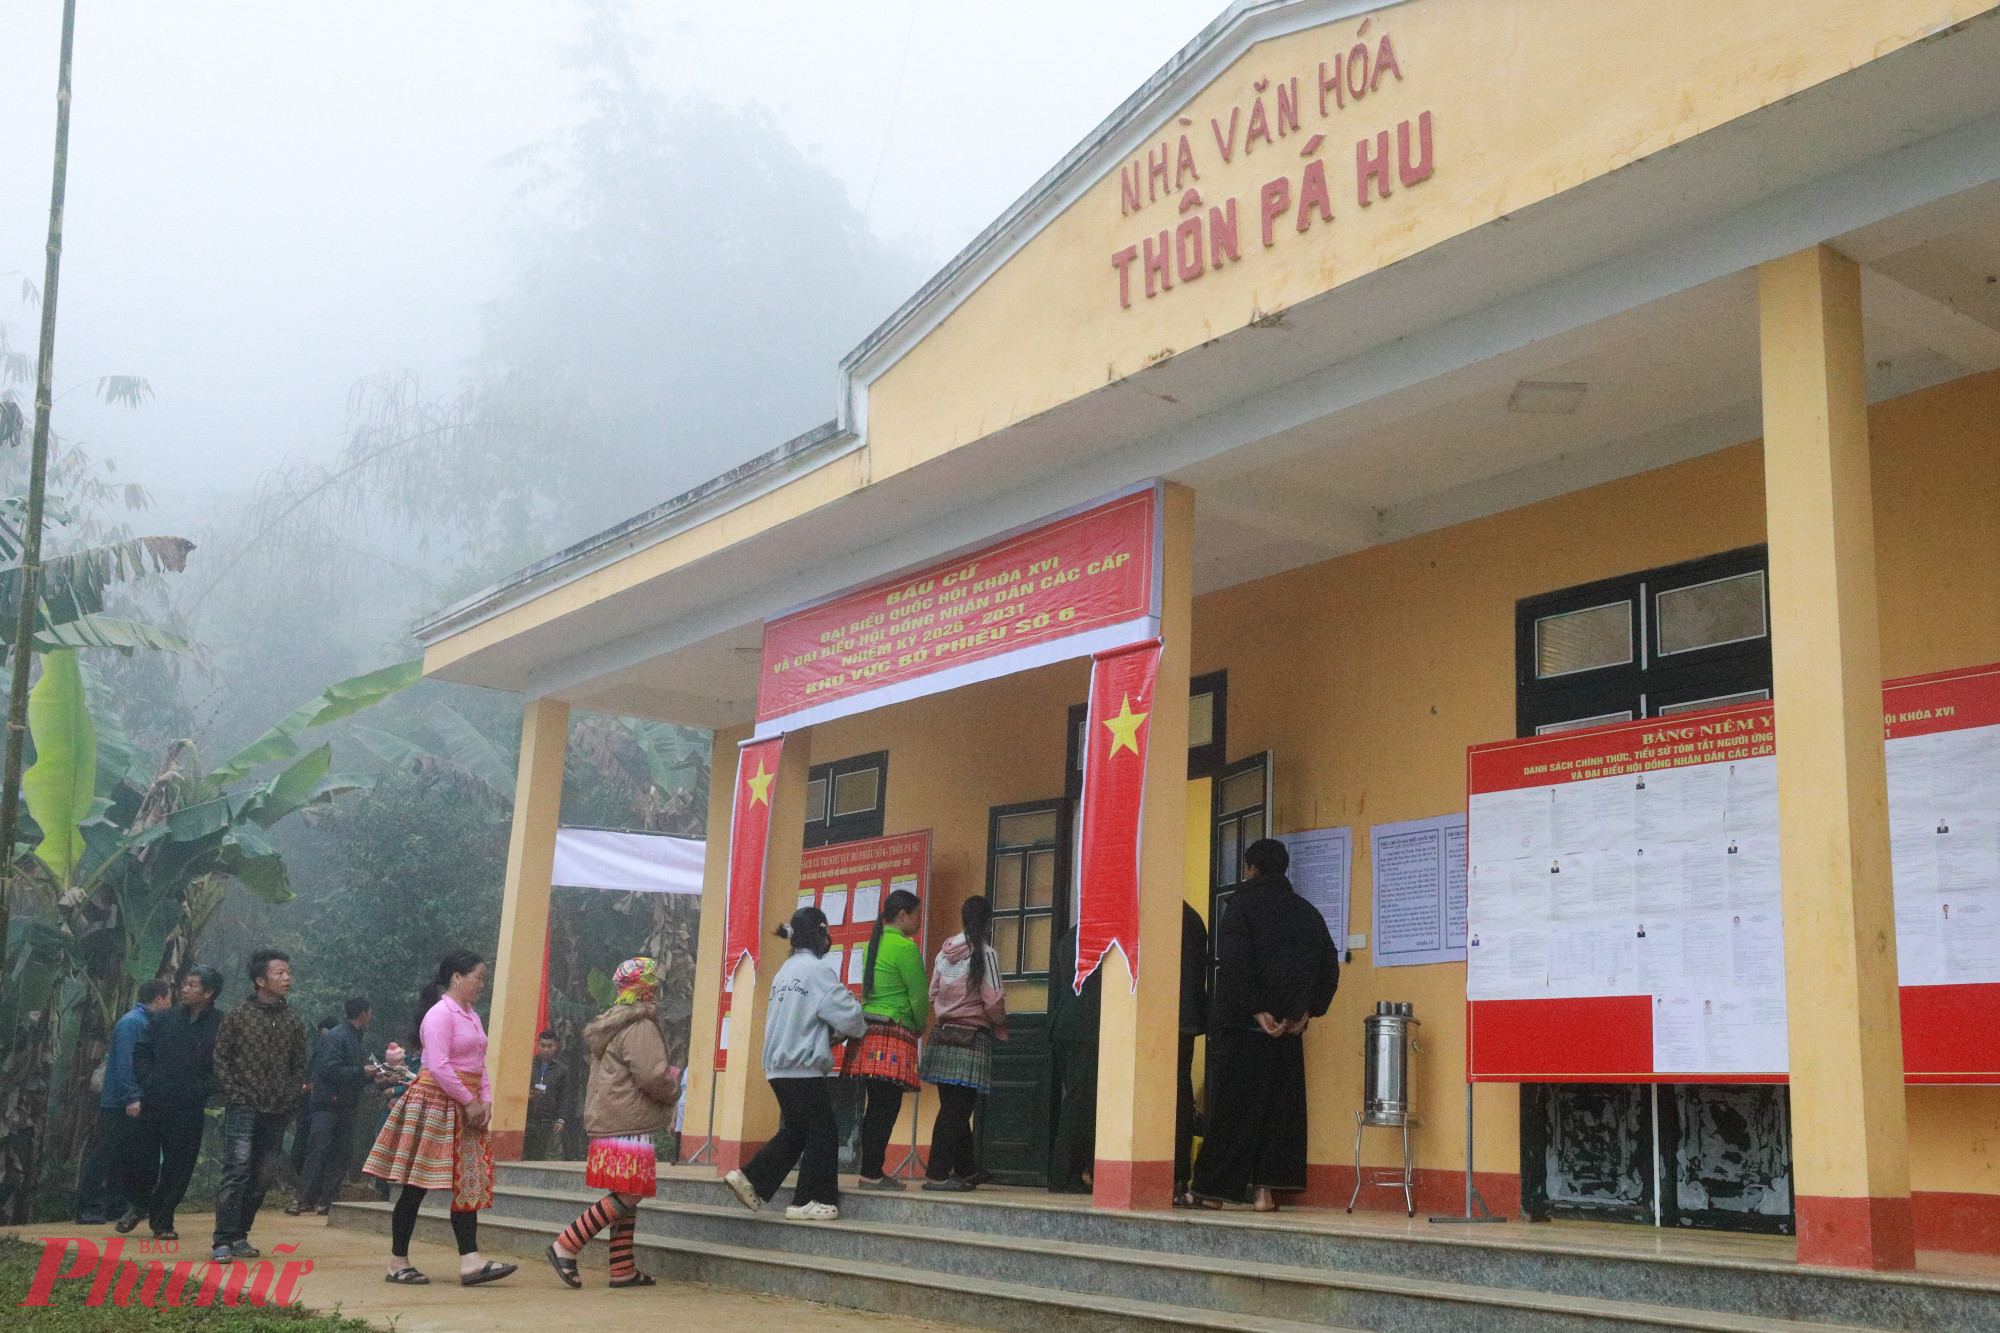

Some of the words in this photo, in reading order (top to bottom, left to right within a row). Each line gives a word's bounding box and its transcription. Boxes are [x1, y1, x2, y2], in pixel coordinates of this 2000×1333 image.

[1122, 116, 1200, 216] NHÀ
[1211, 76, 1300, 162] VĂN
[1319, 17, 1403, 117] HÓA
[1111, 188, 1241, 308] THÔN
[1261, 134, 1334, 247] PÁ
[1356, 110, 1435, 207] HU
[774, 659, 790, 674] VÀ
[794, 650, 818, 667] ĐẠI
[821, 636, 855, 658] BIỂU
[859, 632, 886, 648] HỘI
[889, 613, 935, 637] ĐỒNG
[939, 596, 989, 621] NHÂN
[995, 582, 1034, 604] DÂN
[1040, 568, 1080, 590] CÁC
[1087, 552, 1130, 576] CẤP
[820, 626, 846, 643] ĐẠI
[850, 613, 885, 634] BIỂU
[889, 595, 934, 621] QUỐC
[938, 586, 967, 605] HỘI
[973, 569, 1021, 594] KHÓA
[1027, 556, 1059, 577] XVI
[841, 643, 892, 667] NHIỆM
[896, 633, 918, 650] KỲ
[922, 620, 964, 643] 2026
[982, 603, 1025, 625] 2031
[805, 673, 845, 695] KHU
[851, 659, 892, 681] VỰC
[899, 646, 928, 668] BỎ
[935, 626, 1007, 657] PHIẾU
[1015, 607, 1051, 634] SỐ
[1058, 606, 1075, 621] 6
[1524, 765, 1548, 775] DANH
[1549, 760, 1573, 772] SÁCH
[1575, 755, 1604, 768] CHÍNH
[1634, 746, 1655, 759] TIỂU
[1657, 744, 1672, 756] SỬ
[1673, 742, 1694, 754] TÓM
[1717, 734, 1749, 748] NGƯỜI
[1751, 732, 1774, 743] ỨNG
[1642, 728, 1694, 745] BẢNG
[1700, 718, 1754, 737] NIÊM
[1884, 713, 1897, 726] ỘI
[1900, 709, 1932, 722] KHÓA
[1935, 706, 1955, 718] XVI
[1571, 771, 1583, 780] VÀ
[1585, 768, 1600, 779] ĐẠI
[1602, 762, 1624, 776] BIỂU
[1673, 754, 1703, 766] NHÂN
[1704, 751, 1725, 763] DÂN
[1728, 748, 1749, 759] CÁC
[1751, 742, 1774, 756] CẤP,
